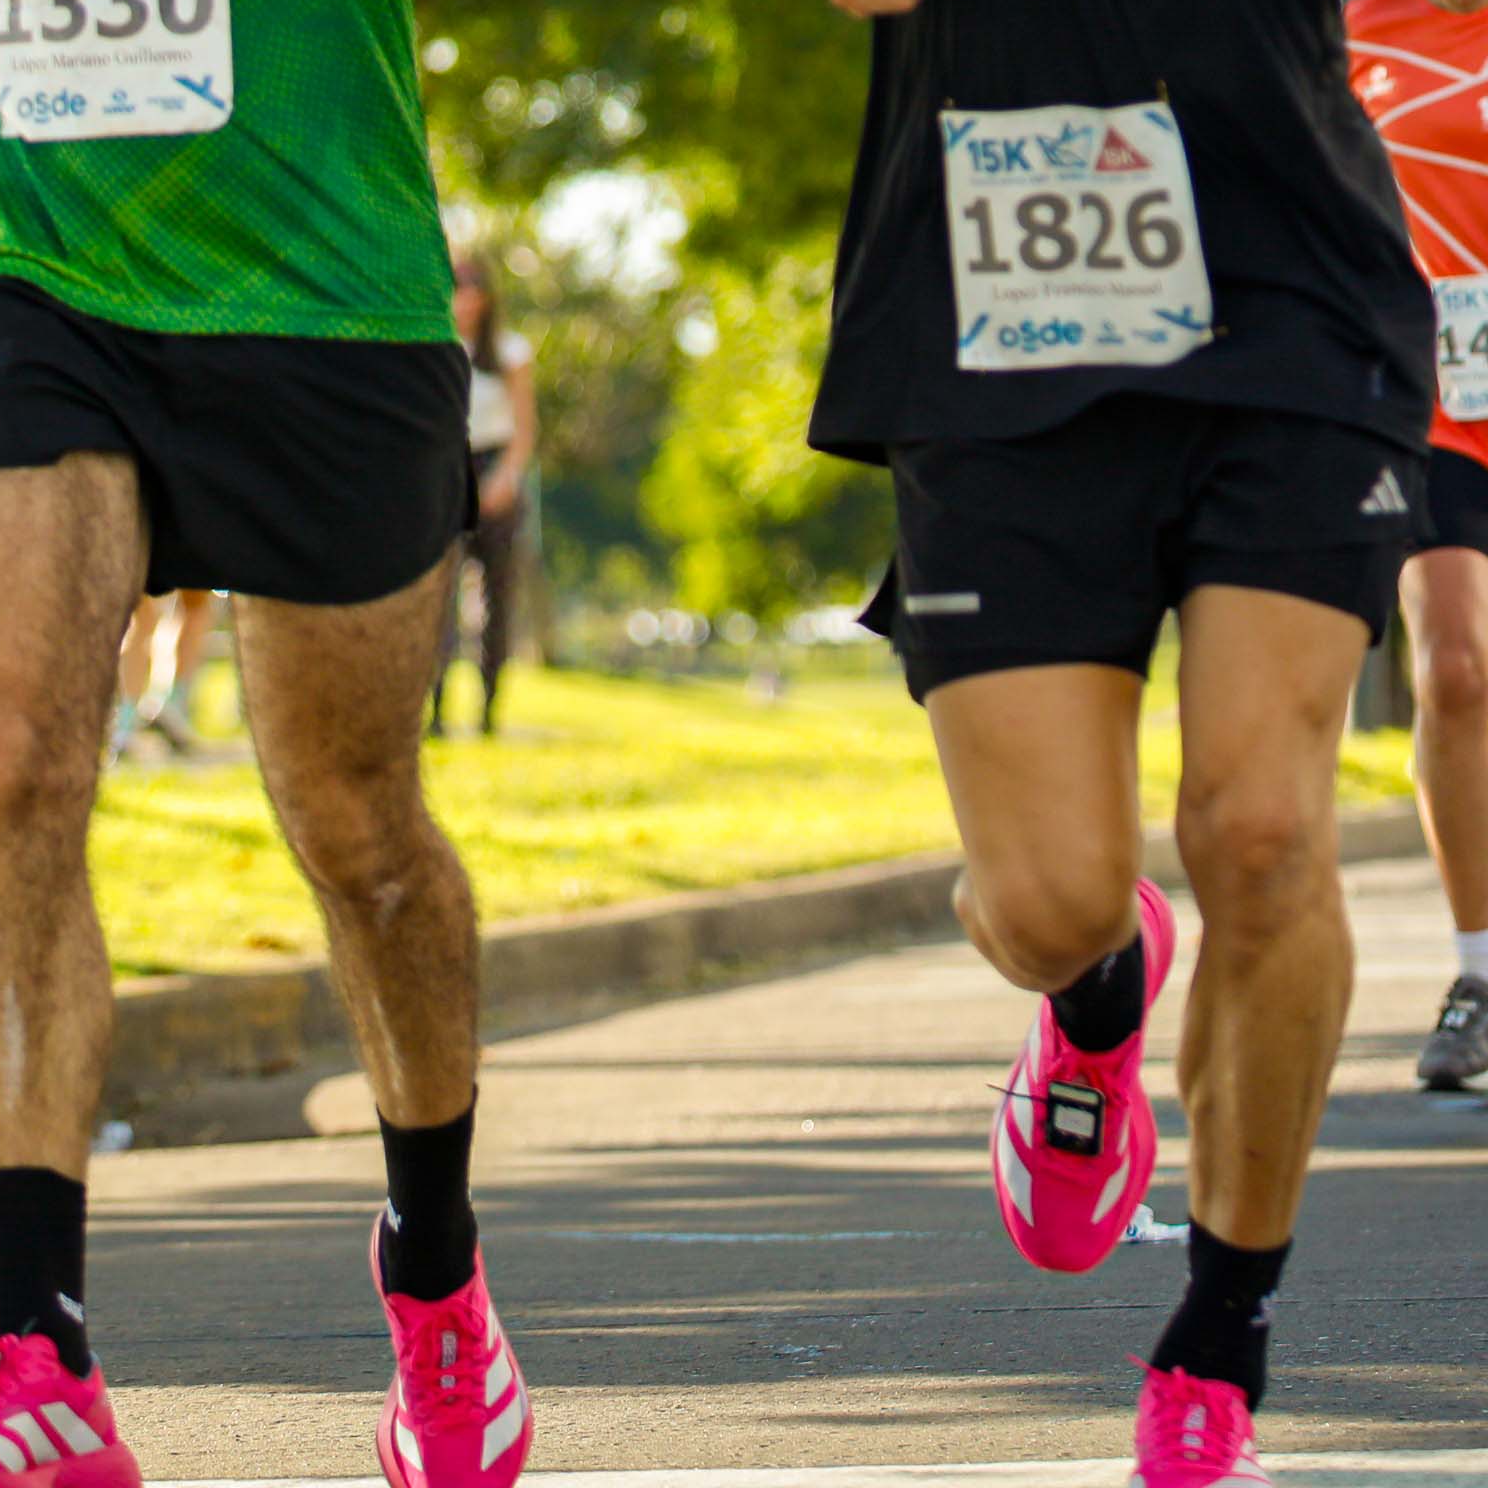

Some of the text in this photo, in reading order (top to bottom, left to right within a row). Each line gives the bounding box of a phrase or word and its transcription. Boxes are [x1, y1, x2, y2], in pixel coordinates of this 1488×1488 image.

[17, 89, 87, 119] osde
[967, 137, 1032, 173] 15K
[963, 188, 1185, 274] 1826
[999, 317, 1084, 349] osde
